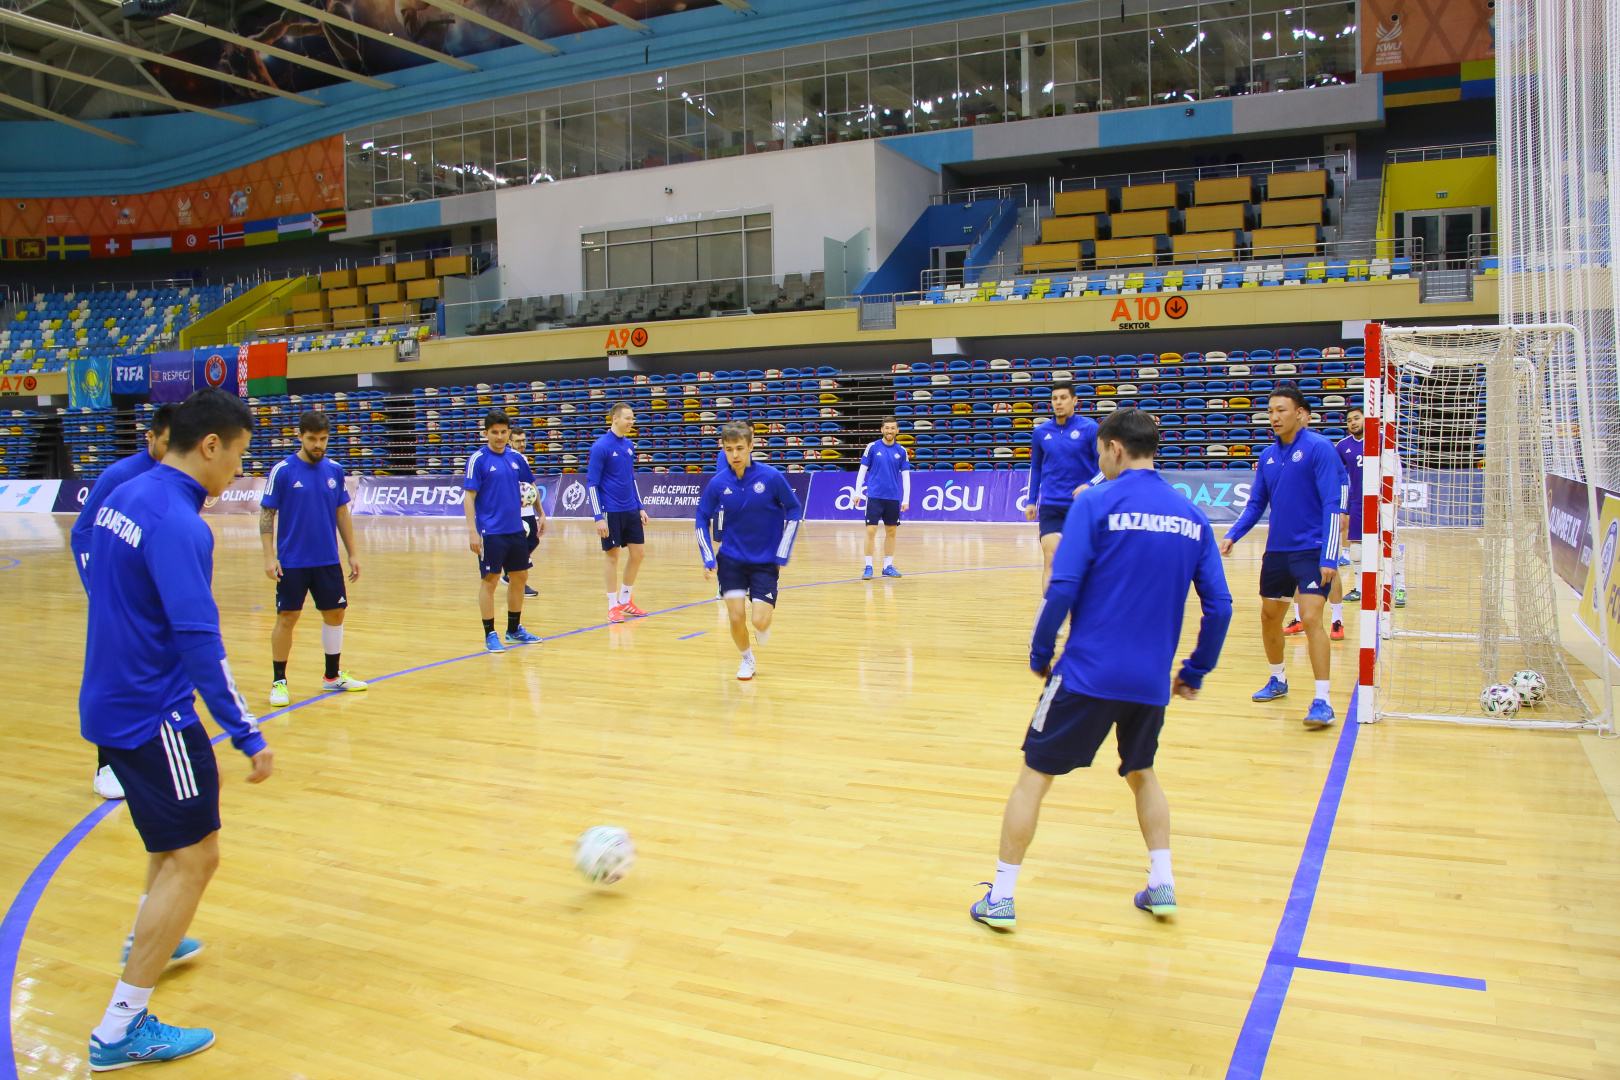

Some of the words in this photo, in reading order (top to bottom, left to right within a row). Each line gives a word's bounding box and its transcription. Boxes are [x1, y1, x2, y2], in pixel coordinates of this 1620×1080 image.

[1376, 42, 1402, 52] KWU
[1118, 321, 1150, 330] SEKTOR
[605, 328, 631, 349] A9
[208, 356, 222, 365] UEFA
[116, 366, 144, 381] FIFA
[162, 369, 191, 381] RESPECT
[221, 489, 264, 501] OLIMPB
[652, 485, 667, 494] БАС
[363, 486, 408, 505] UEFA
[643, 495, 672, 505] GENERAL
[673, 496, 701, 506] PARTNE
[1108, 512, 1202, 541] KAZAKHSTAN
[171, 711, 181, 721] 9
